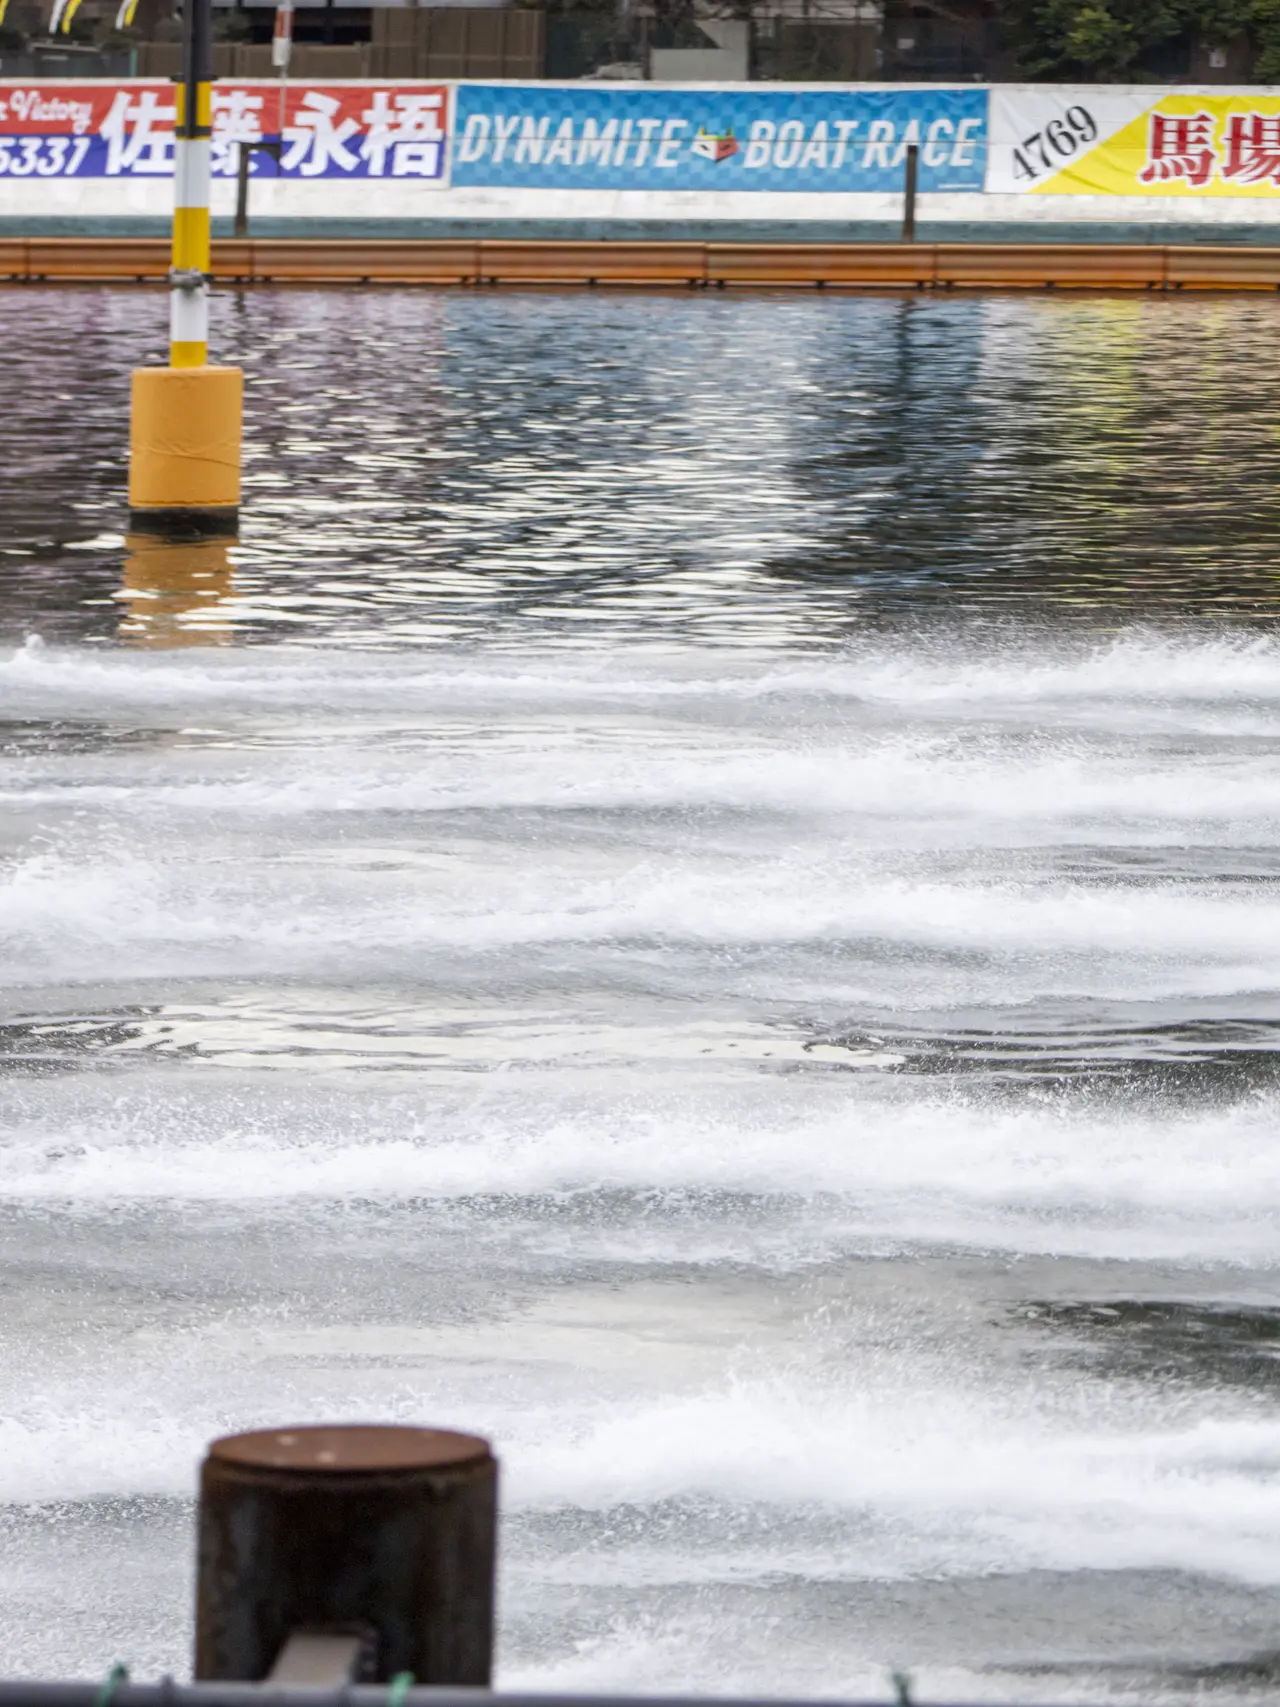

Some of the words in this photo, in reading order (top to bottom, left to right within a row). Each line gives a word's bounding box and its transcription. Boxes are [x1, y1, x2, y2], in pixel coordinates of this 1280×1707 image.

[10, 90, 93, 135] Victory
[458, 114, 688, 167] DYNAMITE
[743, 119, 859, 168] BOAT
[861, 117, 982, 167] RACE
[1011, 104, 1099, 182] 4769
